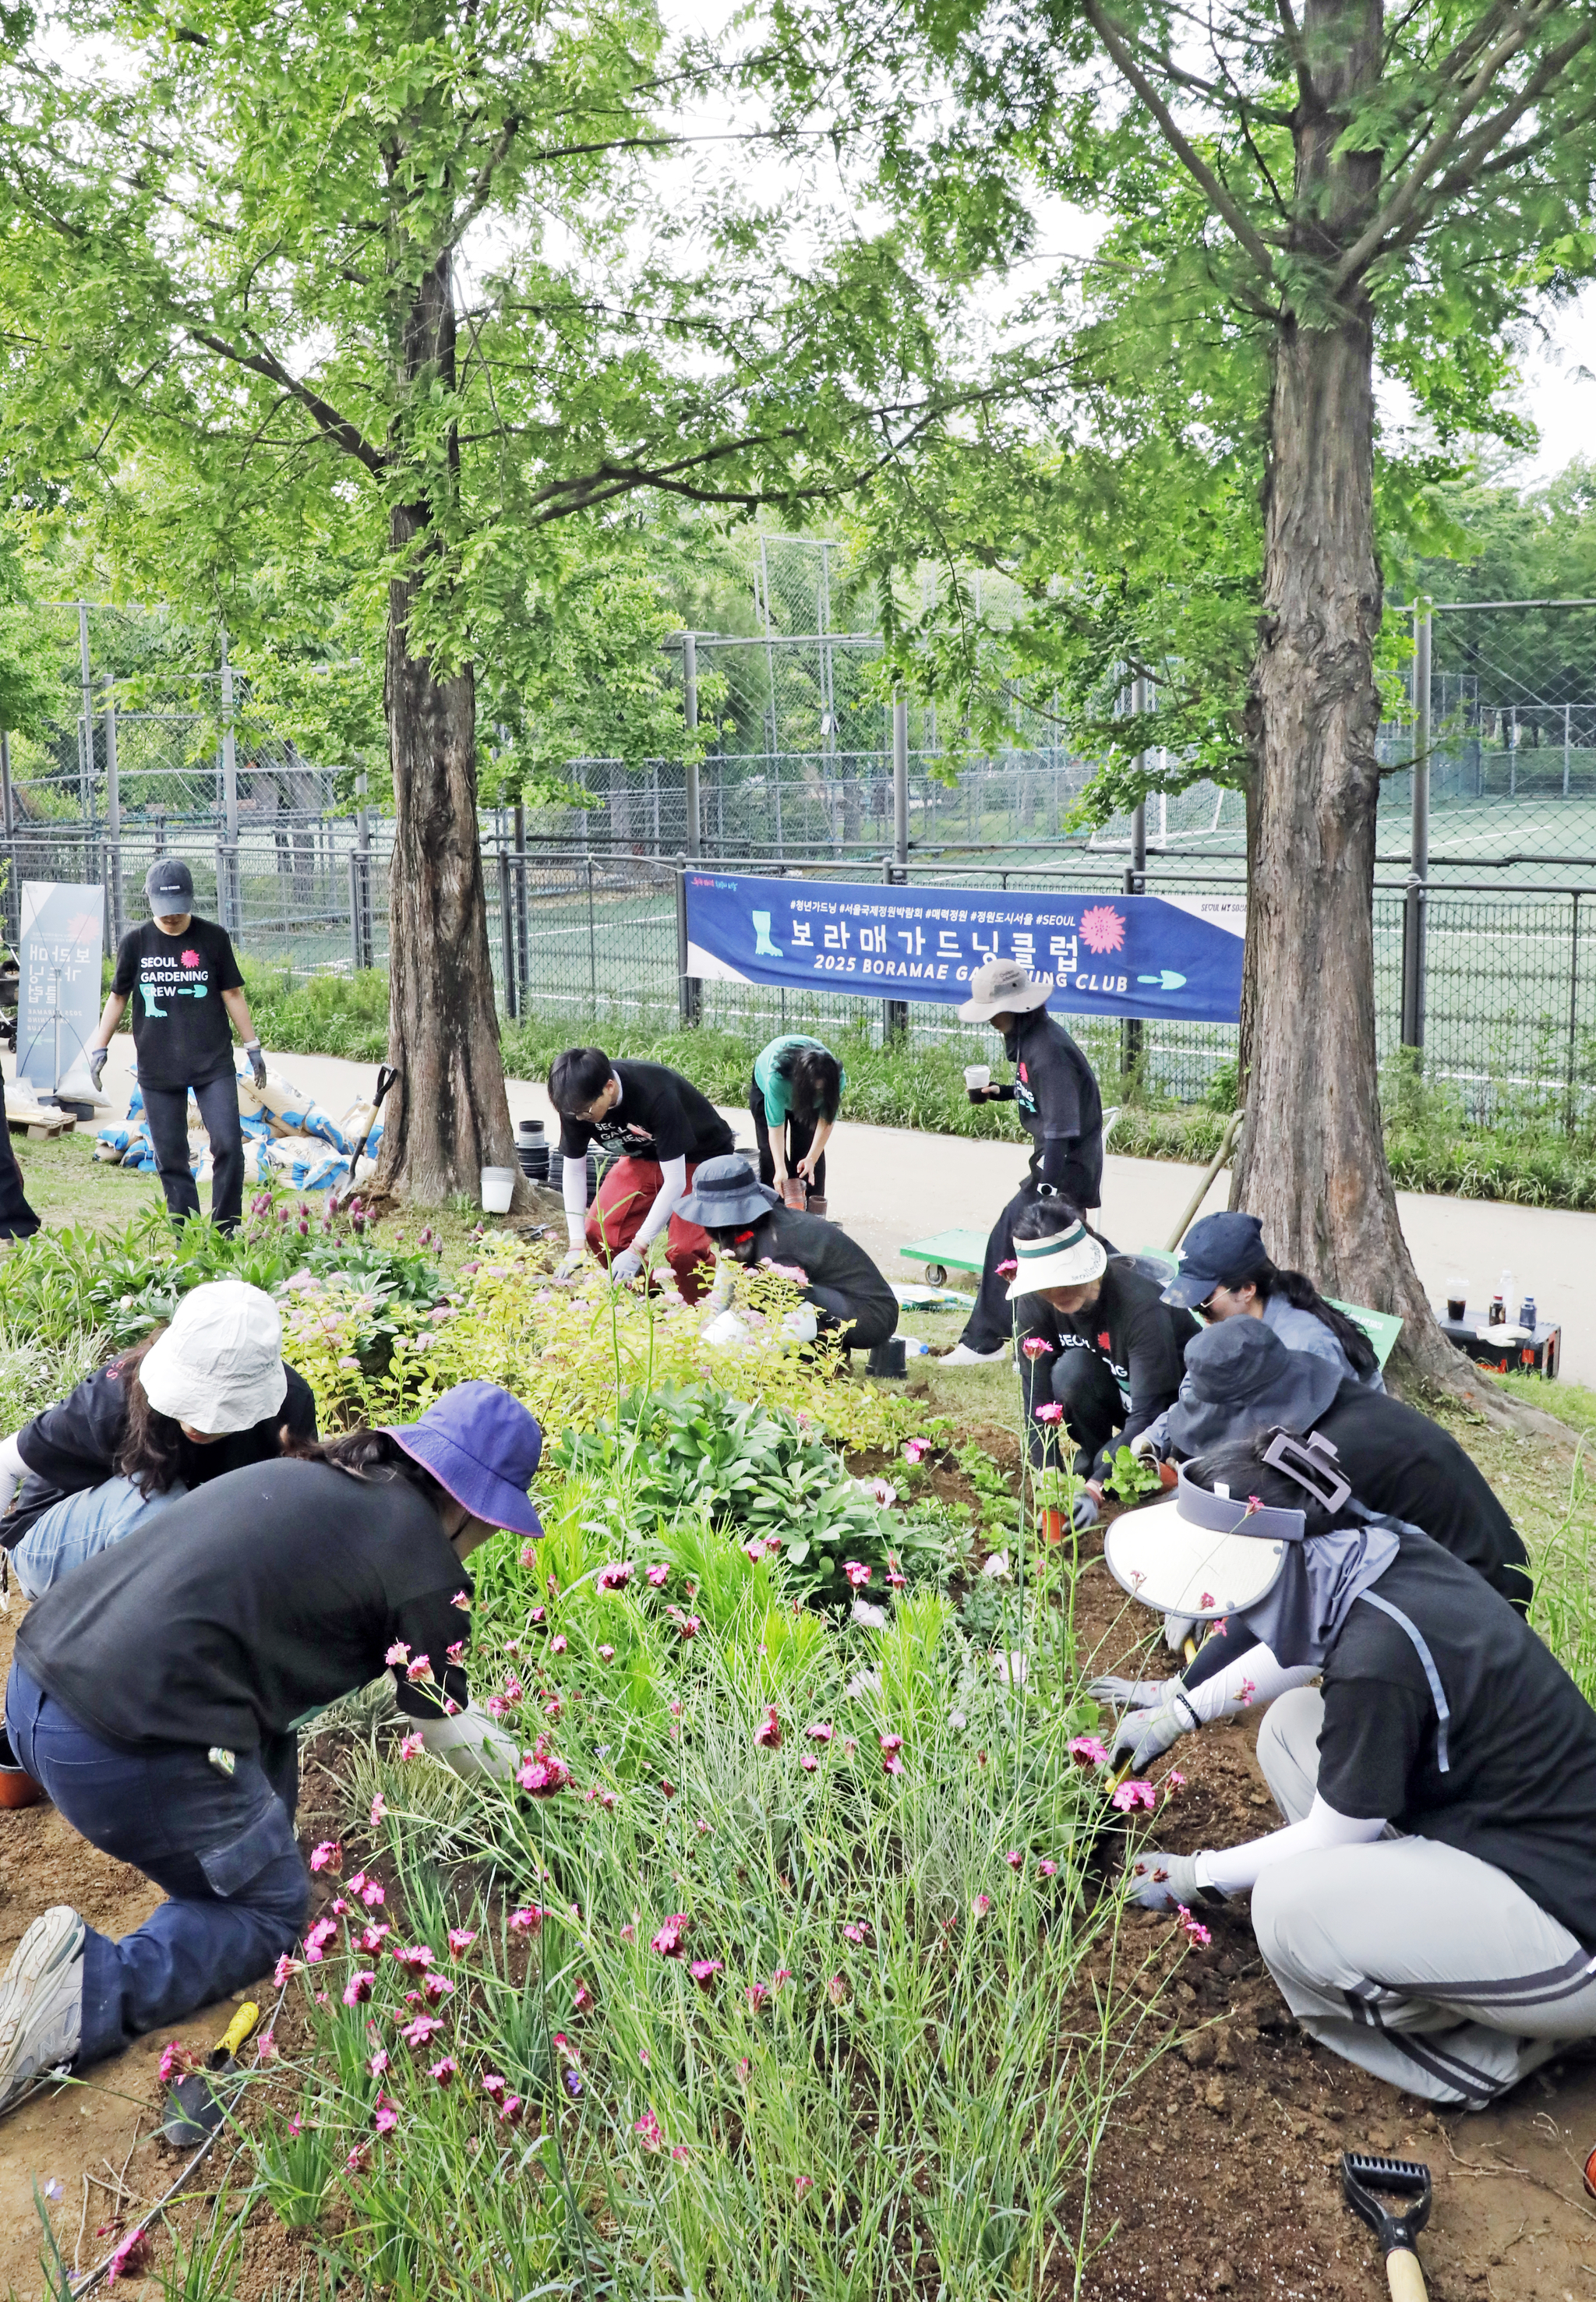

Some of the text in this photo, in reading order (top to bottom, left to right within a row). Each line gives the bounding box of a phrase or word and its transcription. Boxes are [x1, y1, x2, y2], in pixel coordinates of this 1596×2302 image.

[790, 900, 1076, 927] #청년가드닝 #서울국제정원박람회 #매력정원 #정원도시서울 #SEOUL
[140, 956, 178, 968] SEOUL
[140, 971, 208, 983] GARDENING
[814, 955, 856, 972] 2025
[863, 959, 948, 980] BORAMAE
[1075, 974, 1128, 992] CLUB
[143, 986, 176, 997] CREW
